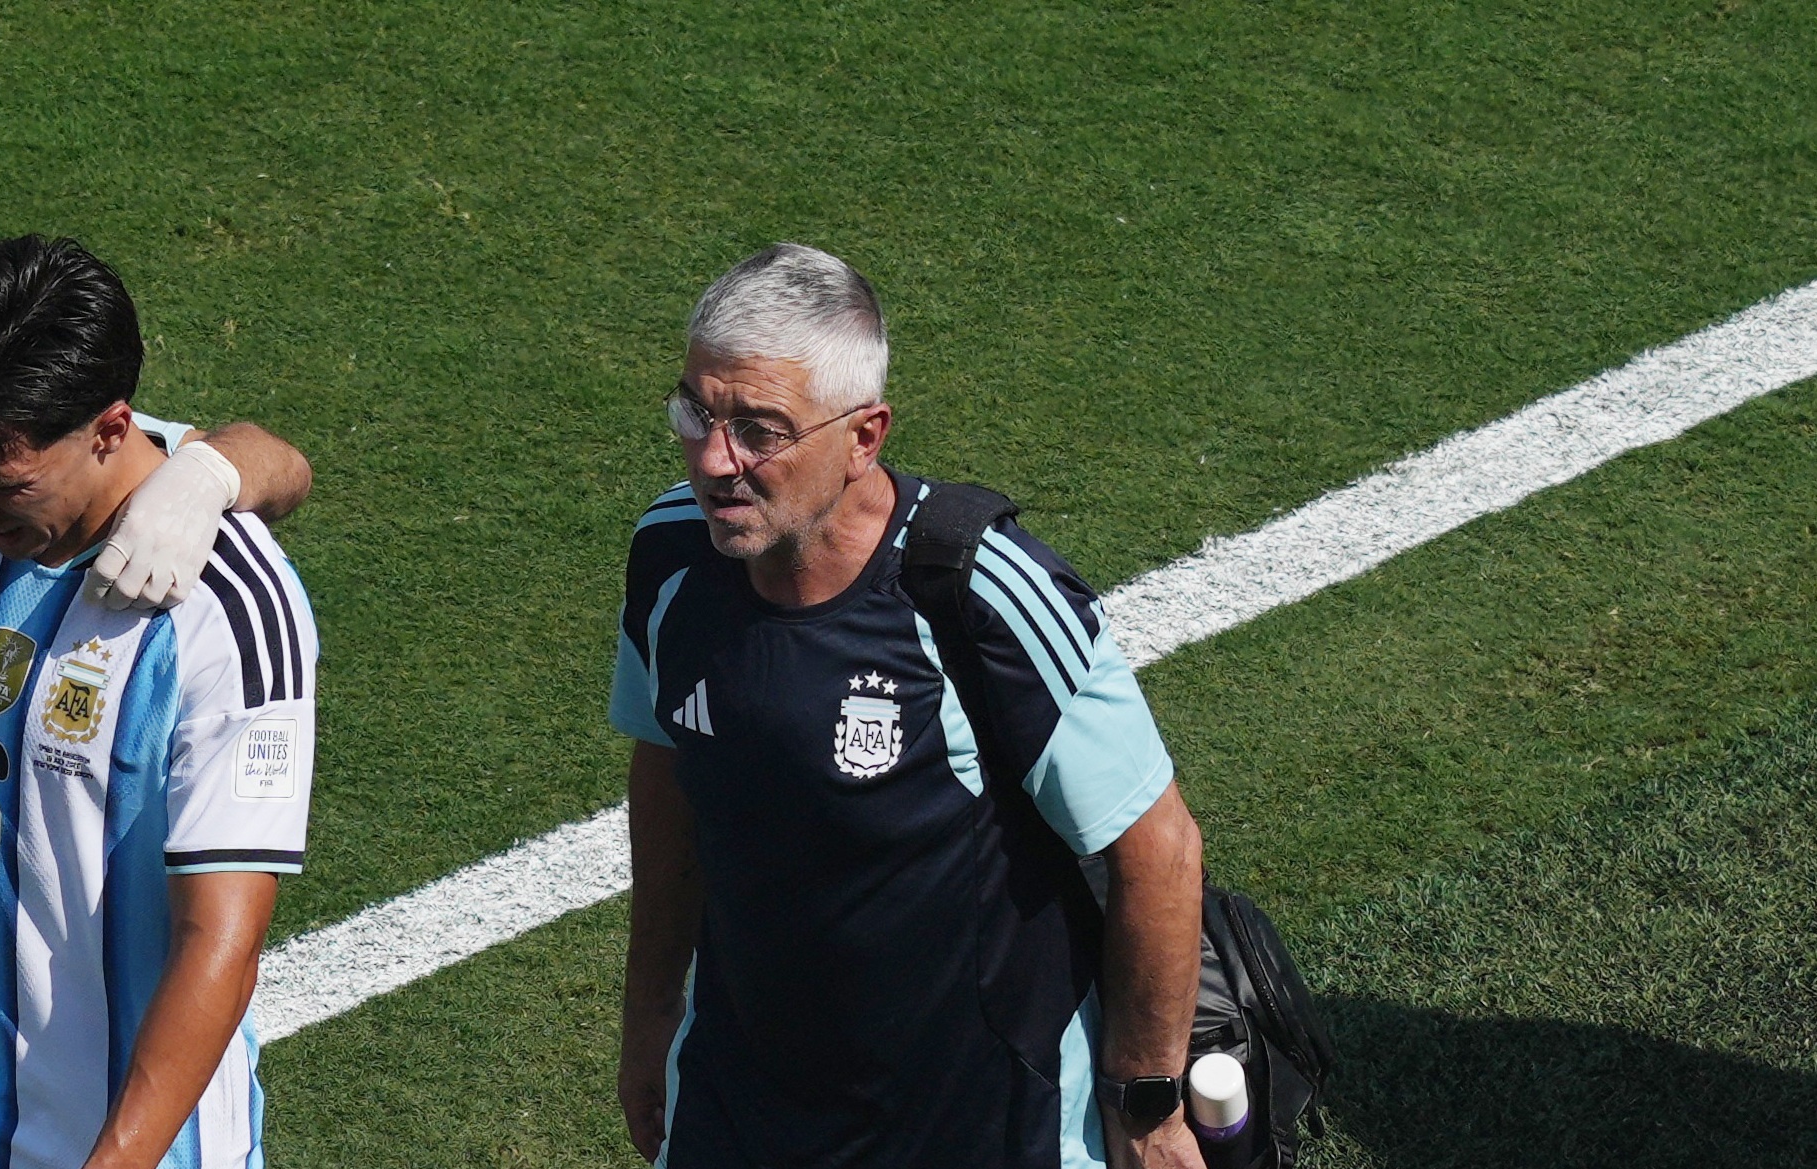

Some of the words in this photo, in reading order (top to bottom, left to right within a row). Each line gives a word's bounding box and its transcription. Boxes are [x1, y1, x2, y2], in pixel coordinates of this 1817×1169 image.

[55, 681, 90, 721] AFA
[248, 730, 289, 742] FOOTBALL
[849, 717, 887, 756] AFA
[248, 743, 289, 760] UNITES
